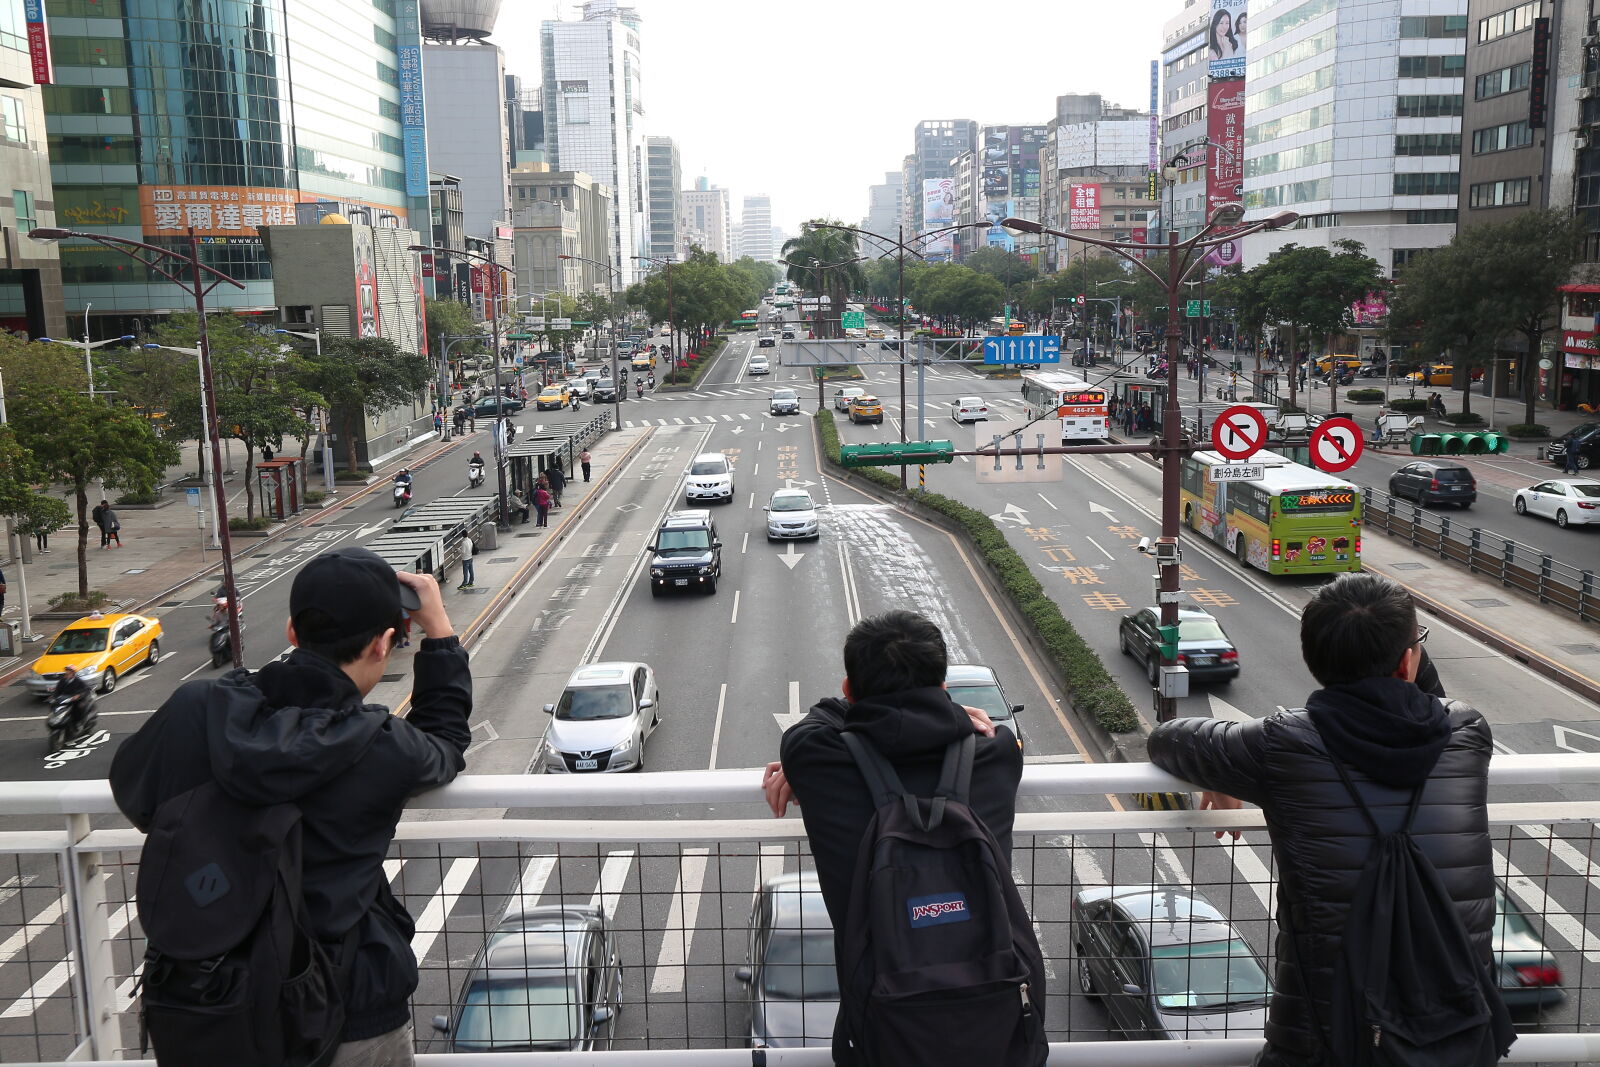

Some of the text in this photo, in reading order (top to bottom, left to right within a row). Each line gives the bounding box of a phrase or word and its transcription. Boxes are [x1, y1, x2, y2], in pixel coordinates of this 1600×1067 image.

[410, 47, 424, 126] Green World Hotel
[154, 191, 172, 200] HD
[1075, 187, 1095, 198] 全棟
[154, 203, 297, 230] 愛爾達電視台
[1213, 466, 1262, 479] 劃分島左側
[1281, 495, 1299, 509] 262
[912, 900, 964, 921] JANSPORT
